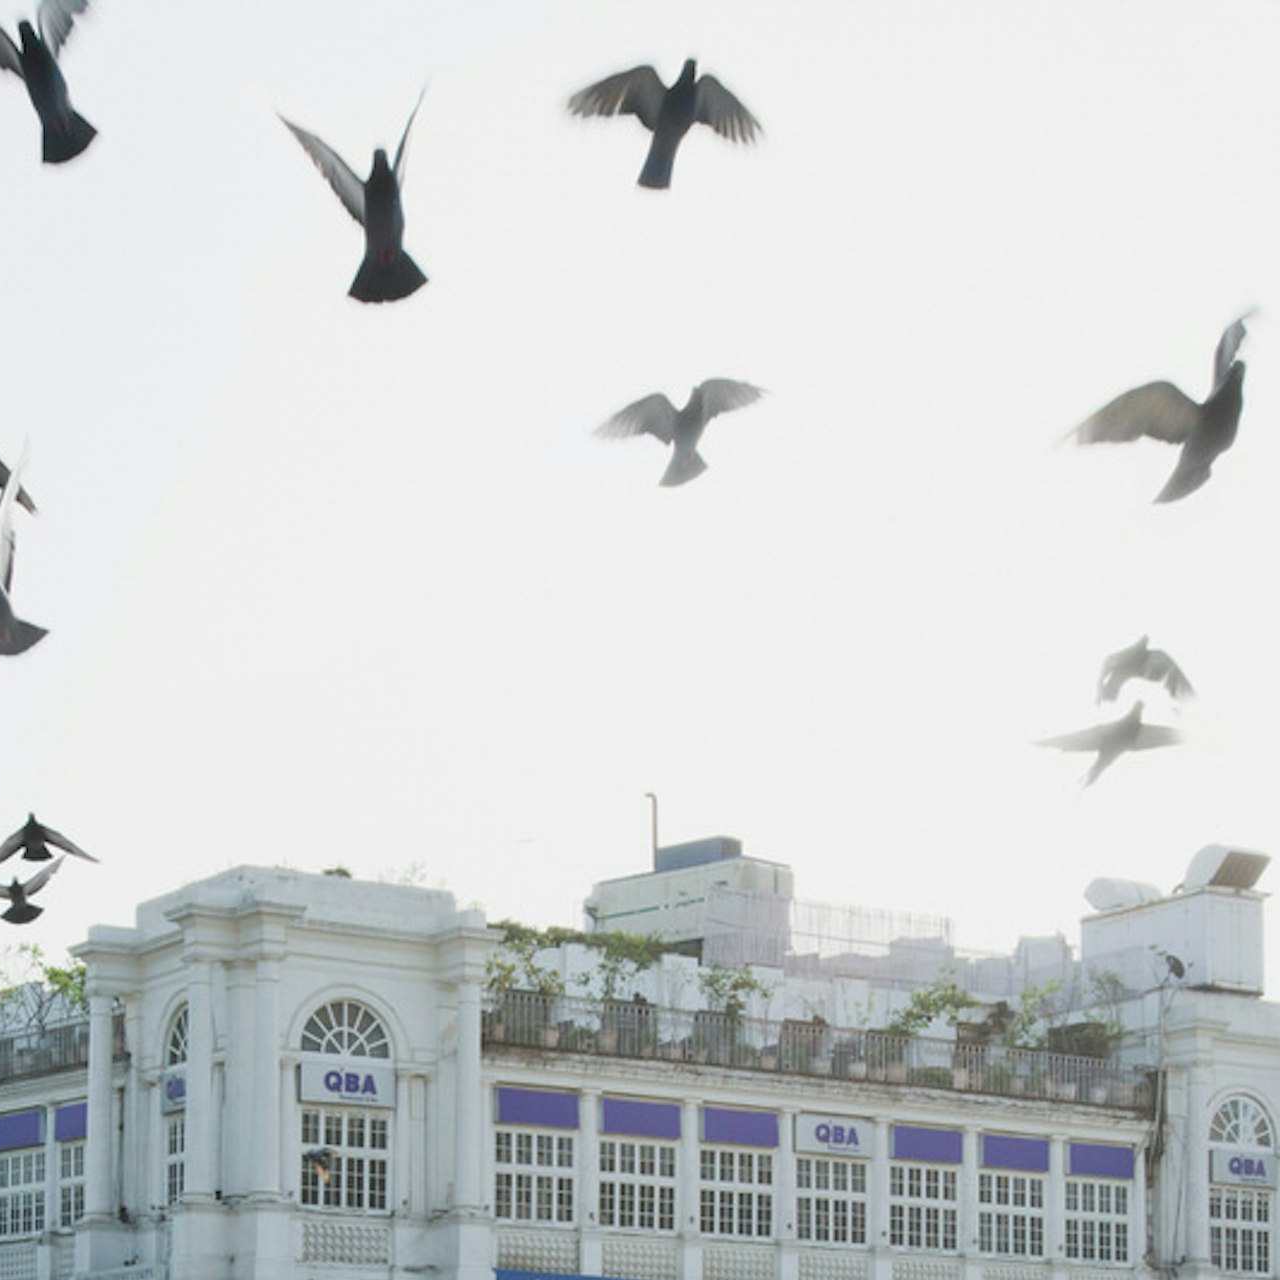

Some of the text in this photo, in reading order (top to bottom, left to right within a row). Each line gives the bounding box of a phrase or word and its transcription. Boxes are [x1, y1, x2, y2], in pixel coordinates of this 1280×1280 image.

[323, 1071, 378, 1095] QBA
[815, 1122, 860, 1146] QBA
[1228, 1156, 1267, 1177] QBA
